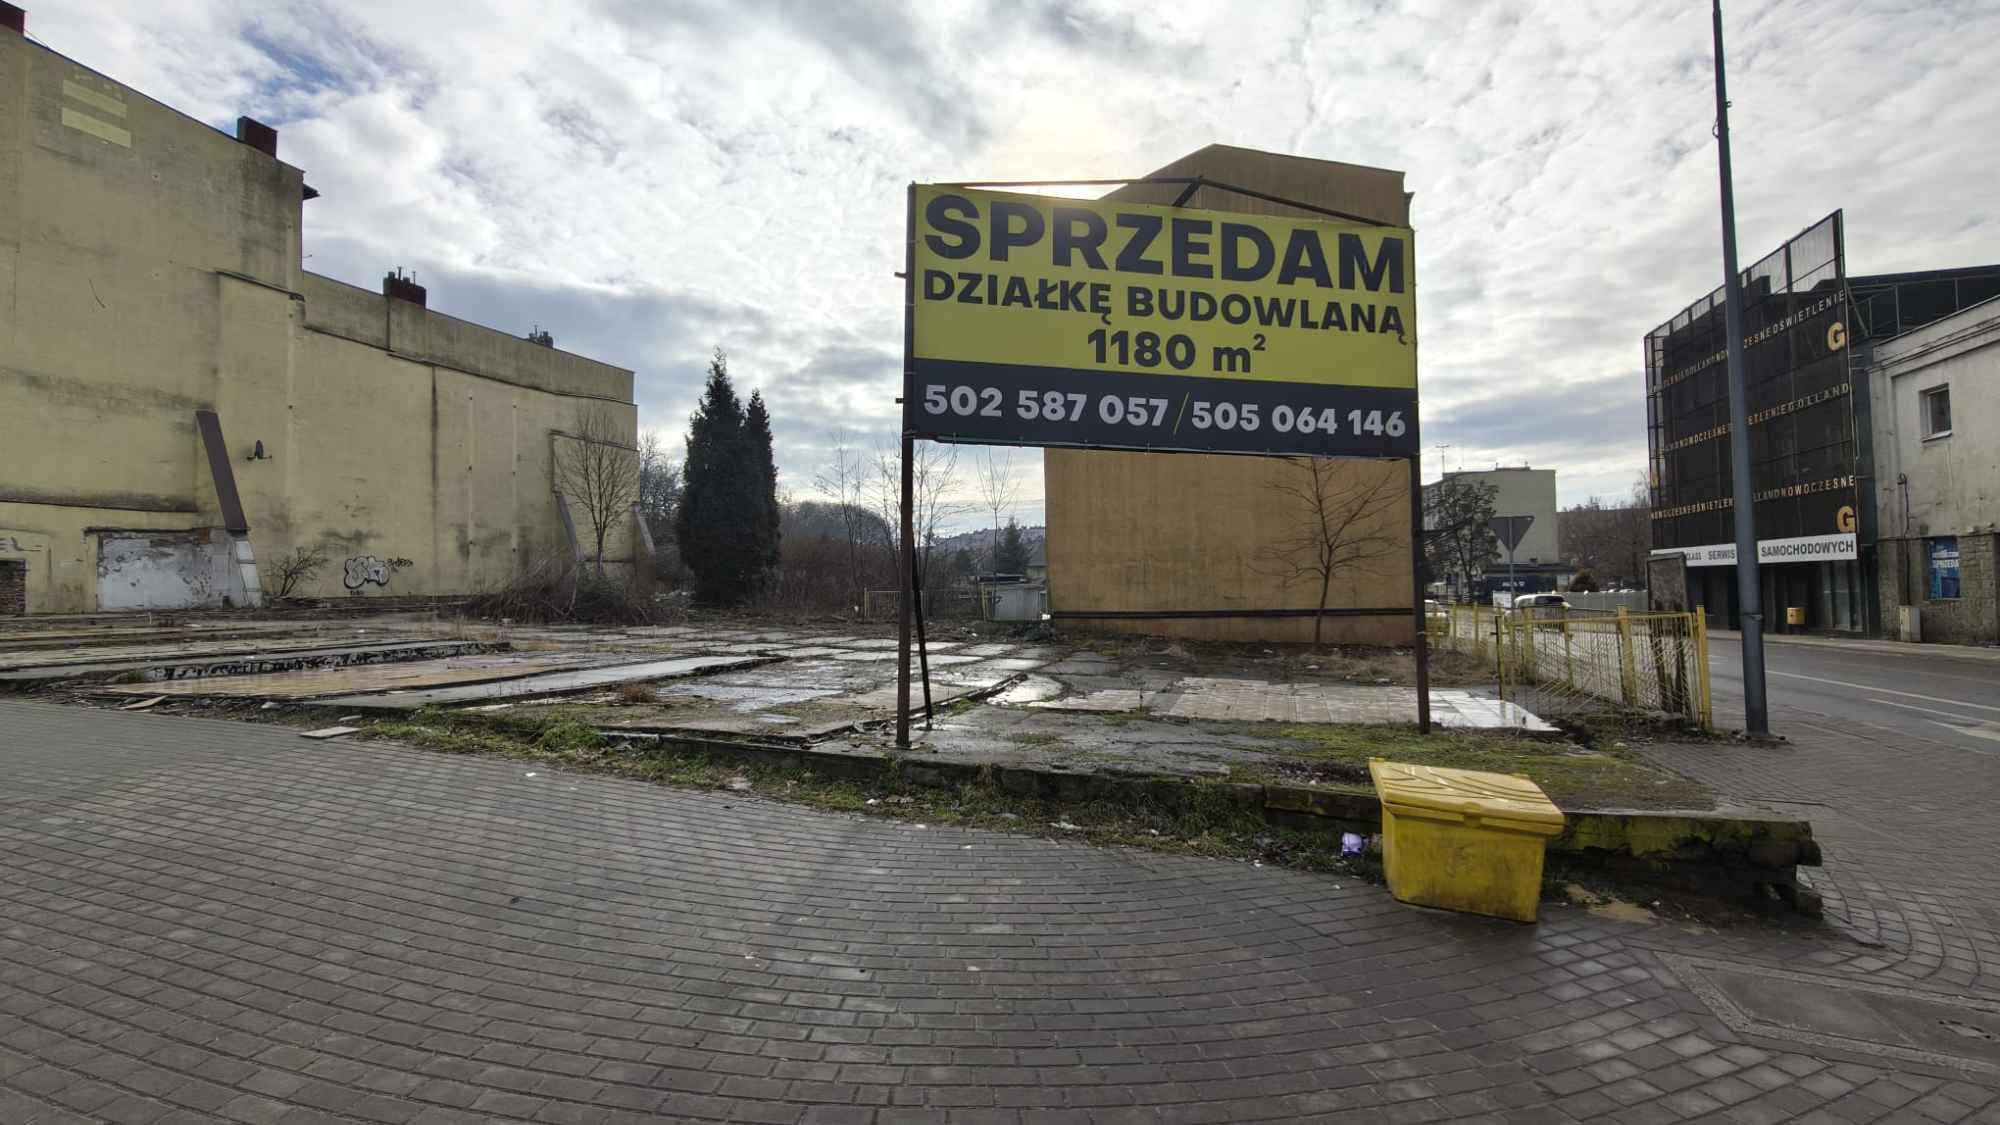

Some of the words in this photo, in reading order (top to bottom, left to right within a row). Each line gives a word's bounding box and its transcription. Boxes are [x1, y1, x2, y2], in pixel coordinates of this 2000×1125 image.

[924, 194, 1406, 295] SPRZEDAM
[923, 269, 1112, 326] DZIAŁKĘ
[1127, 285, 1410, 346] BUDOWLANĄ
[1087, 329, 1196, 371] 1180
[924, 385, 1003, 417] 502
[1016, 390, 1087, 422] 587
[1098, 395, 1169, 426] 057
[1191, 402, 1260, 431] 505
[1271, 405, 1338, 435] 064
[1347, 410, 1406, 437] 146
[1708, 549, 1735, 560] SERWIS
[1761, 540, 1854, 557] SAMOCHODOWYCH
